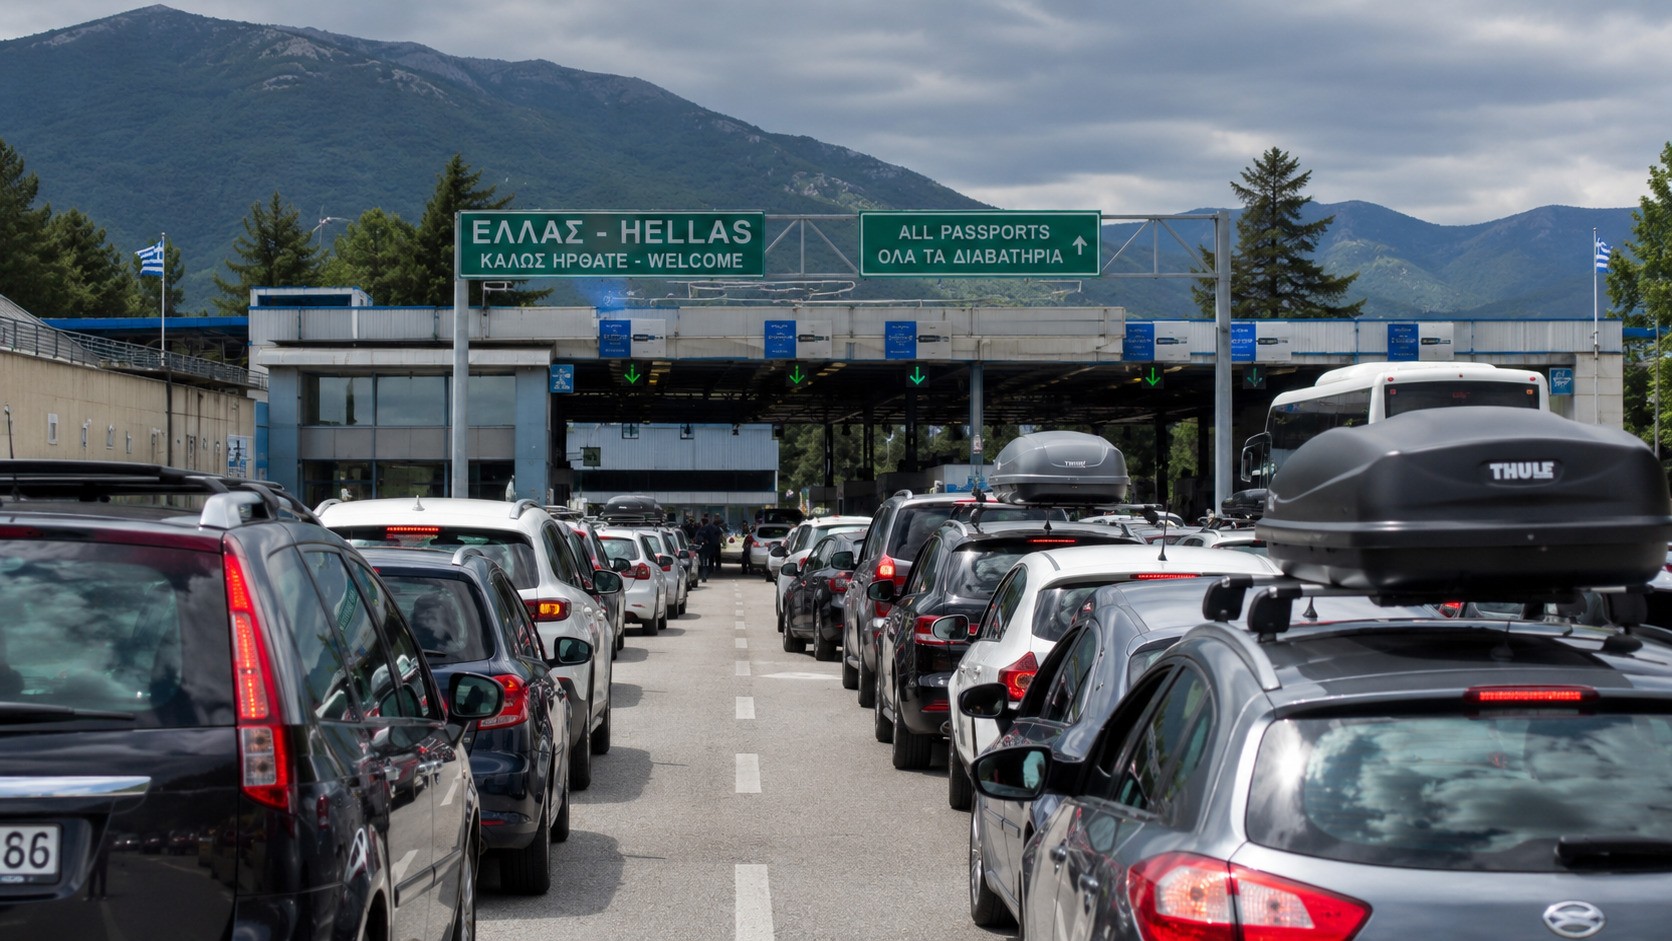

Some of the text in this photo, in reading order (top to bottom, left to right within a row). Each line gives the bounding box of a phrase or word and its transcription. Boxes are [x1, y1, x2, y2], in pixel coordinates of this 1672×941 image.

[472, 220, 584, 244] ΕΛΛΑΣ
[620, 219, 752, 244] HELLAS
[898, 224, 1050, 240] ALL PASSPORTS
[480, 252, 546, 269] ΚΑΛΩΣ
[553, 252, 628, 269] ΗΡΘΑΤΕ
[648, 252, 743, 269] WELCOME
[878, 249, 1064, 264] ΟΛΑ ΤΑ ΔΙΑΒΑΤΗΡΙΑ
[1489, 461, 1554, 480] THULE
[3, 831, 50, 869] 86
